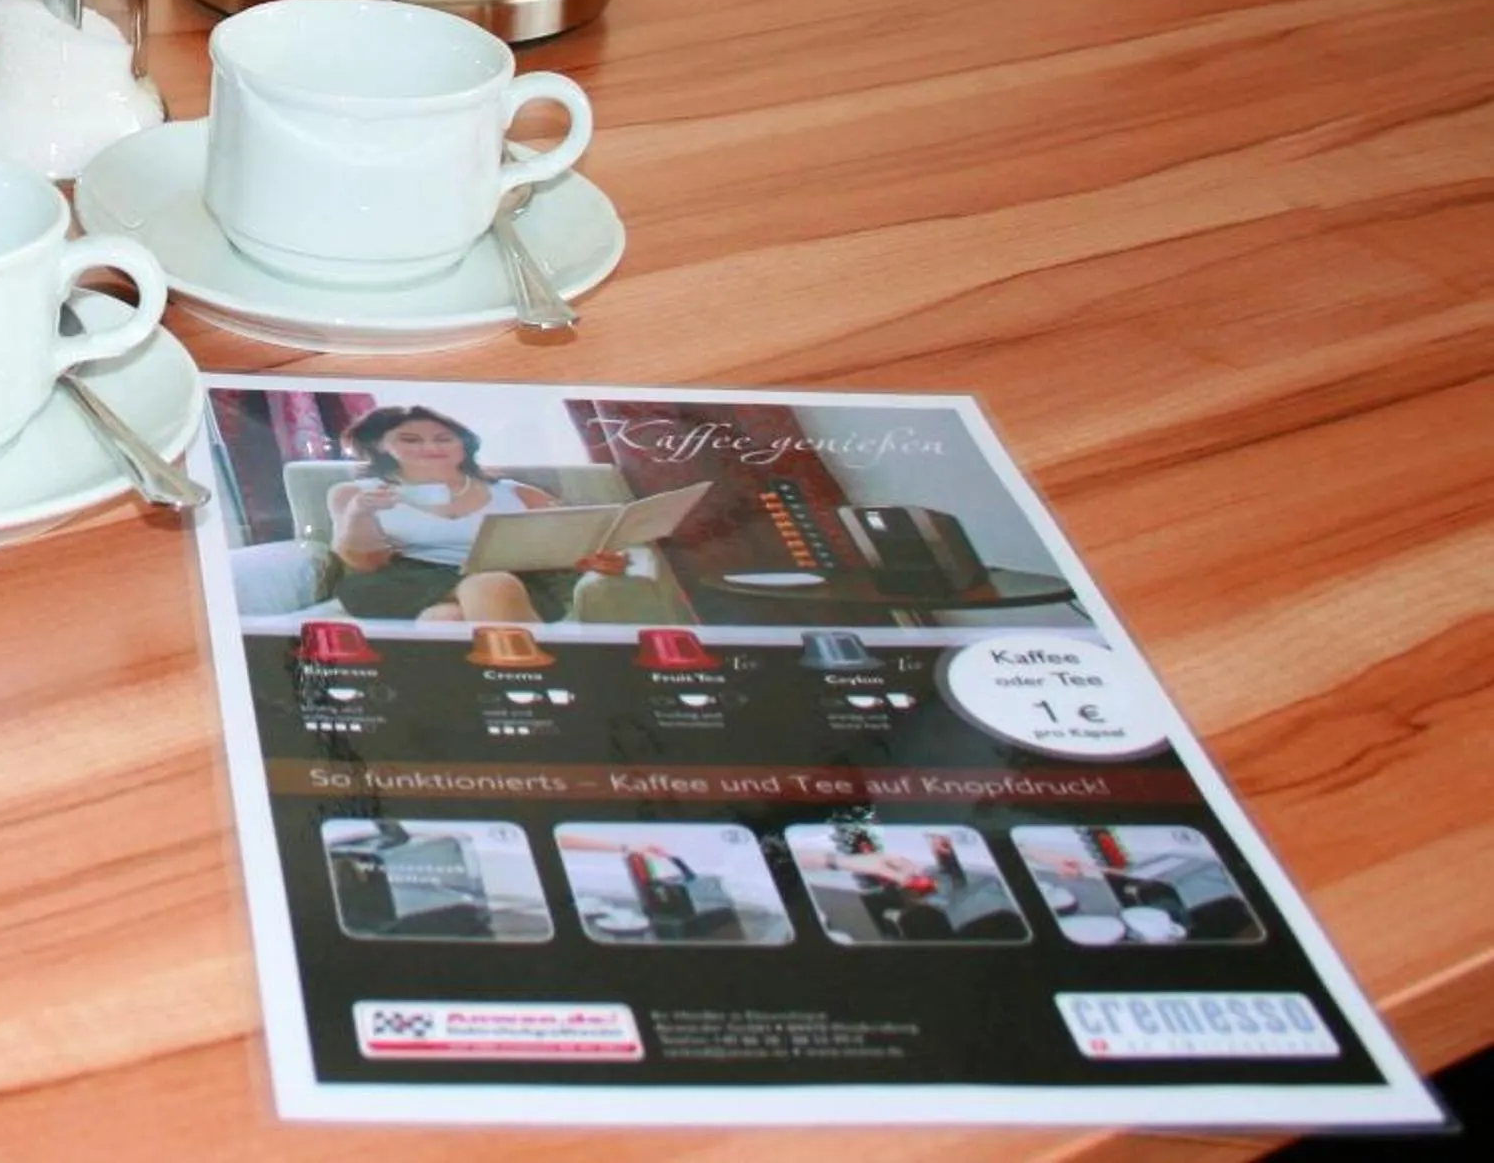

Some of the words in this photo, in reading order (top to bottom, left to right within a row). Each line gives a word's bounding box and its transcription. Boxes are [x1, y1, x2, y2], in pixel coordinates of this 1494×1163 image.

[586, 418, 754, 464] Kaffee
[990, 648, 1081, 665] Kaffee
[482, 669, 544, 681] Crema
[651, 671, 695, 683] Fruit
[823, 674, 885, 687] Ceylon
[994, 674, 1045, 688] oder
[1049, 671, 1104, 687] Tee
[1032, 699, 1058, 724] 1
[1077, 703, 1107, 724] €
[1032, 729, 1065, 740] pro
[1069, 727, 1127, 740] Kapsel
[309, 769, 352, 789] So
[363, 771, 569, 793] funktionierts
[609, 773, 708, 794] Kaffee
[721, 774, 781, 794] und
[788, 774, 854, 794] Tee
[864, 775, 910, 795] auf
[920, 774, 1111, 799] Knopfdruck!
[1069, 996, 1317, 1036] cremesso
